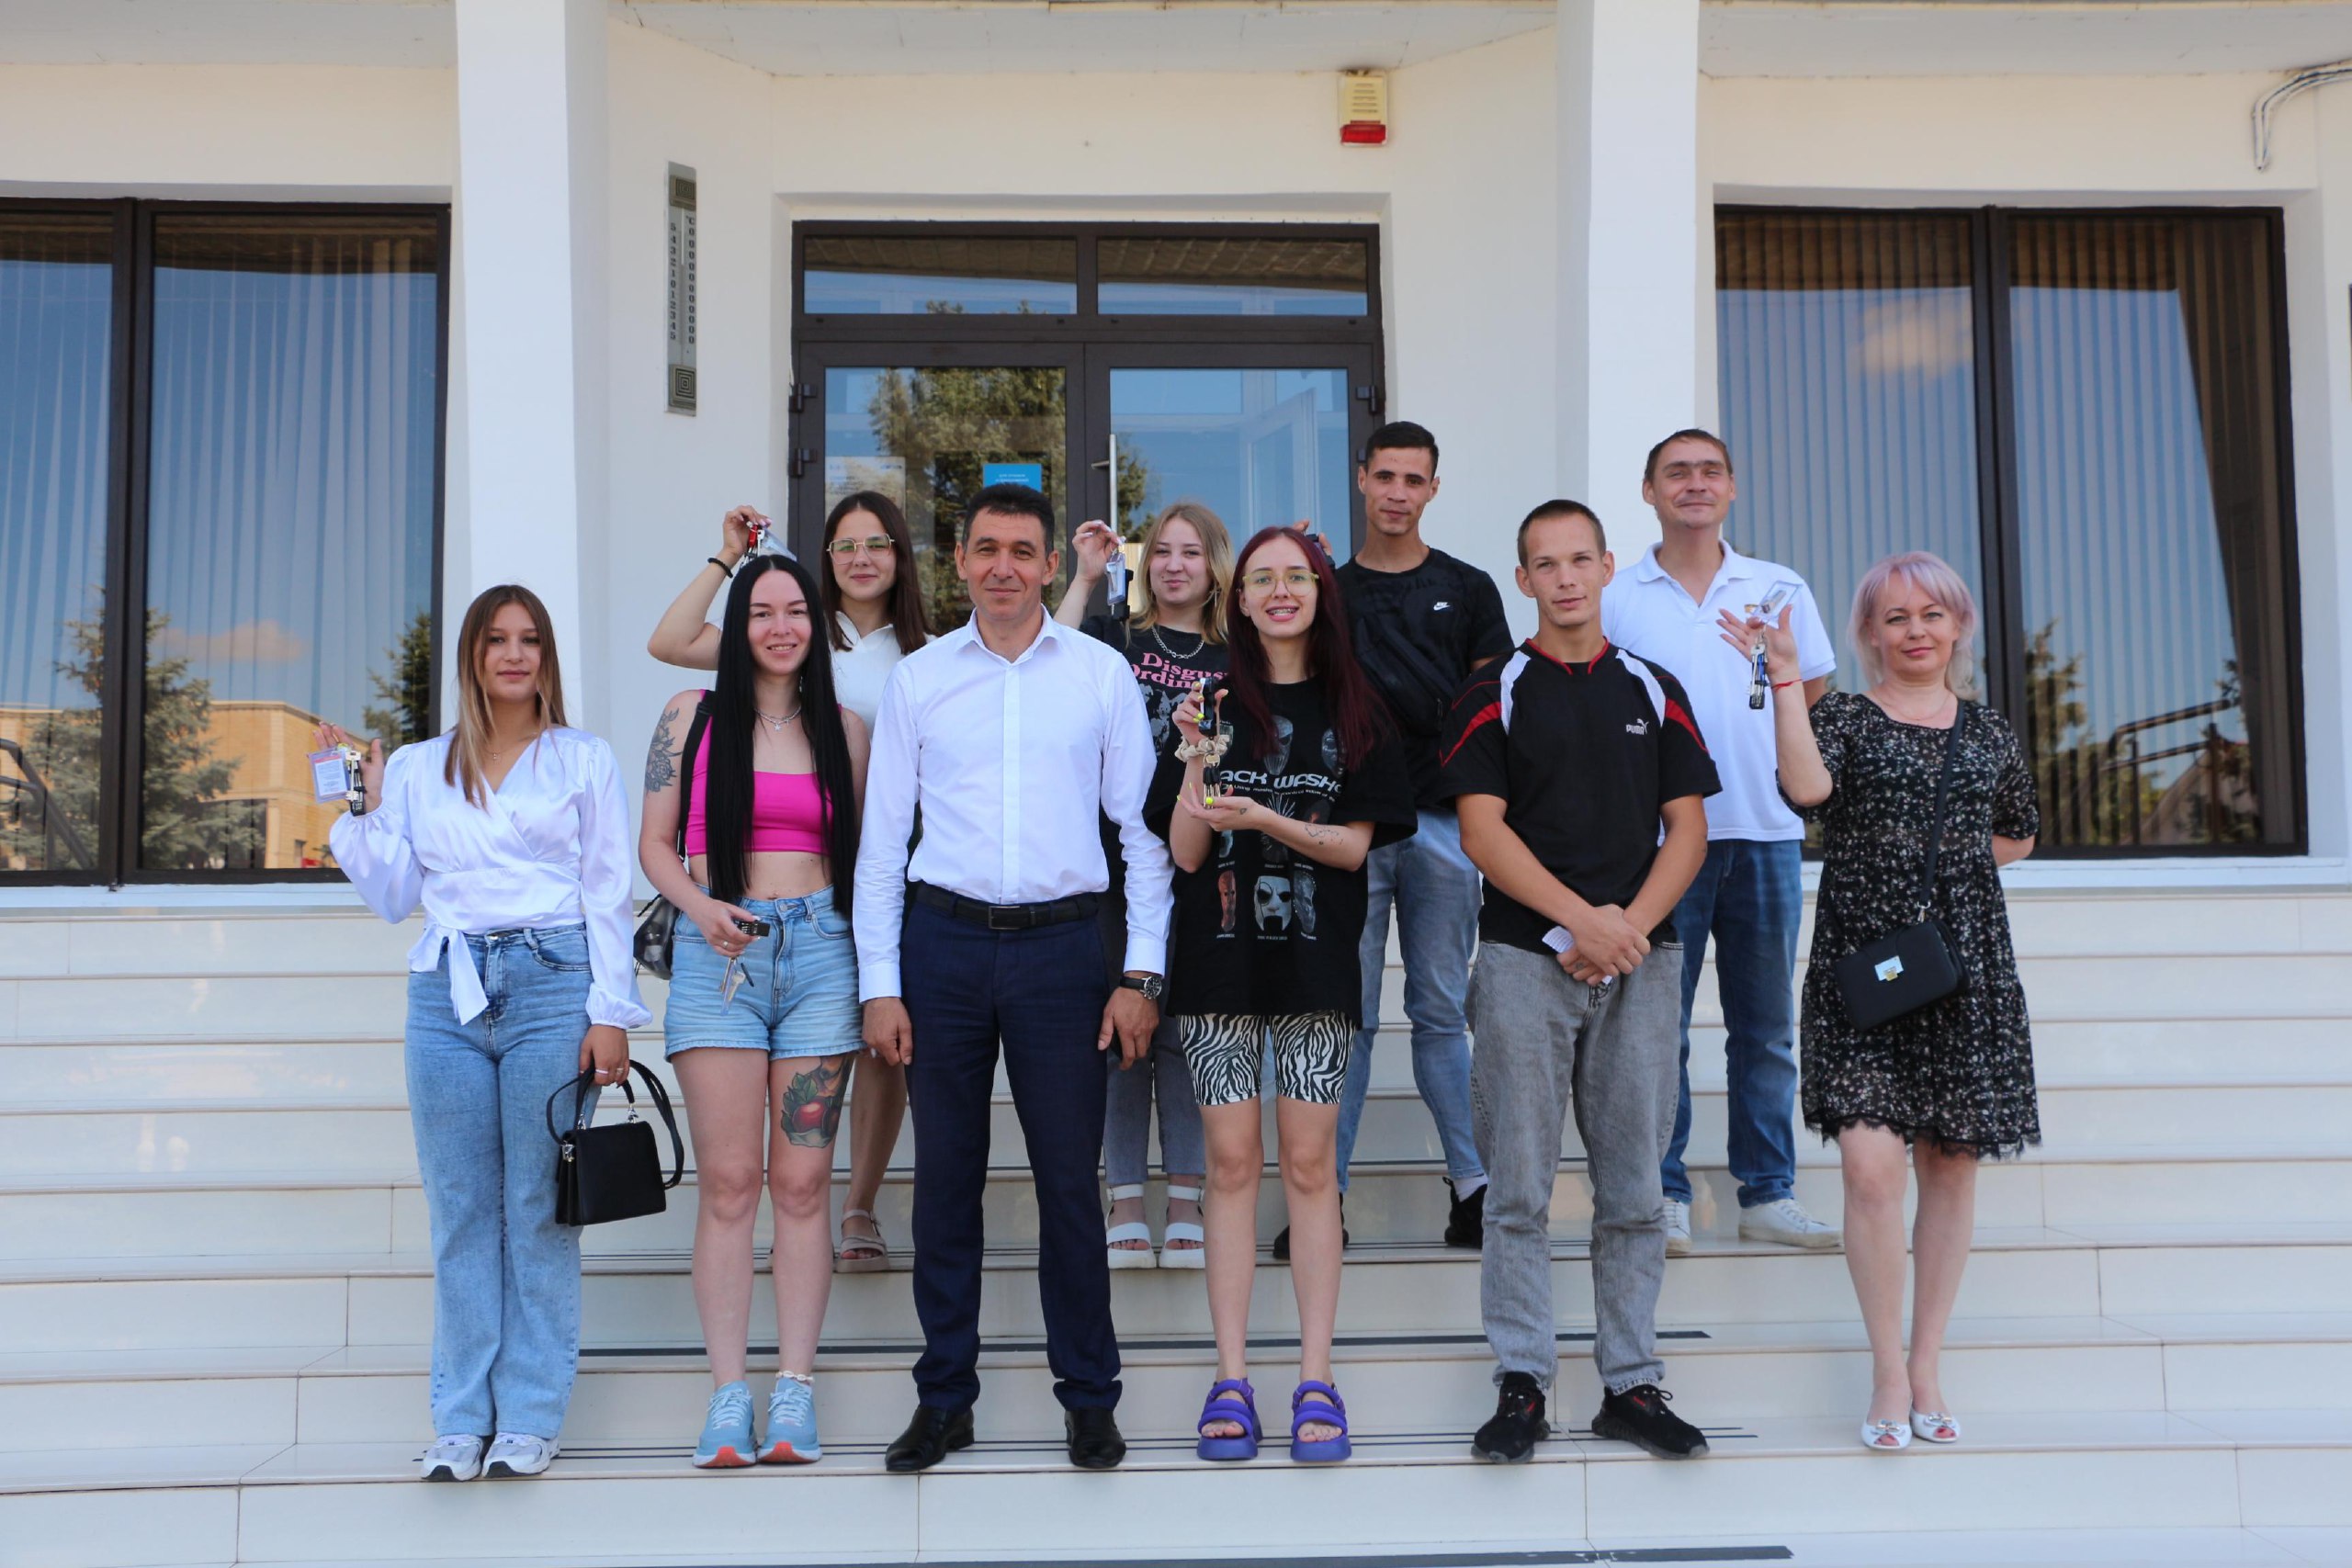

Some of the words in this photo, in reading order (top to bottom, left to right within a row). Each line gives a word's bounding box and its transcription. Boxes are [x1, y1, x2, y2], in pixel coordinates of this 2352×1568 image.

[1130, 663, 1193, 689] rdin
[1141, 652, 1228, 681] Disgus
[1625, 724, 1645, 736] PUMA
[1220, 770, 1267, 784] ACK
